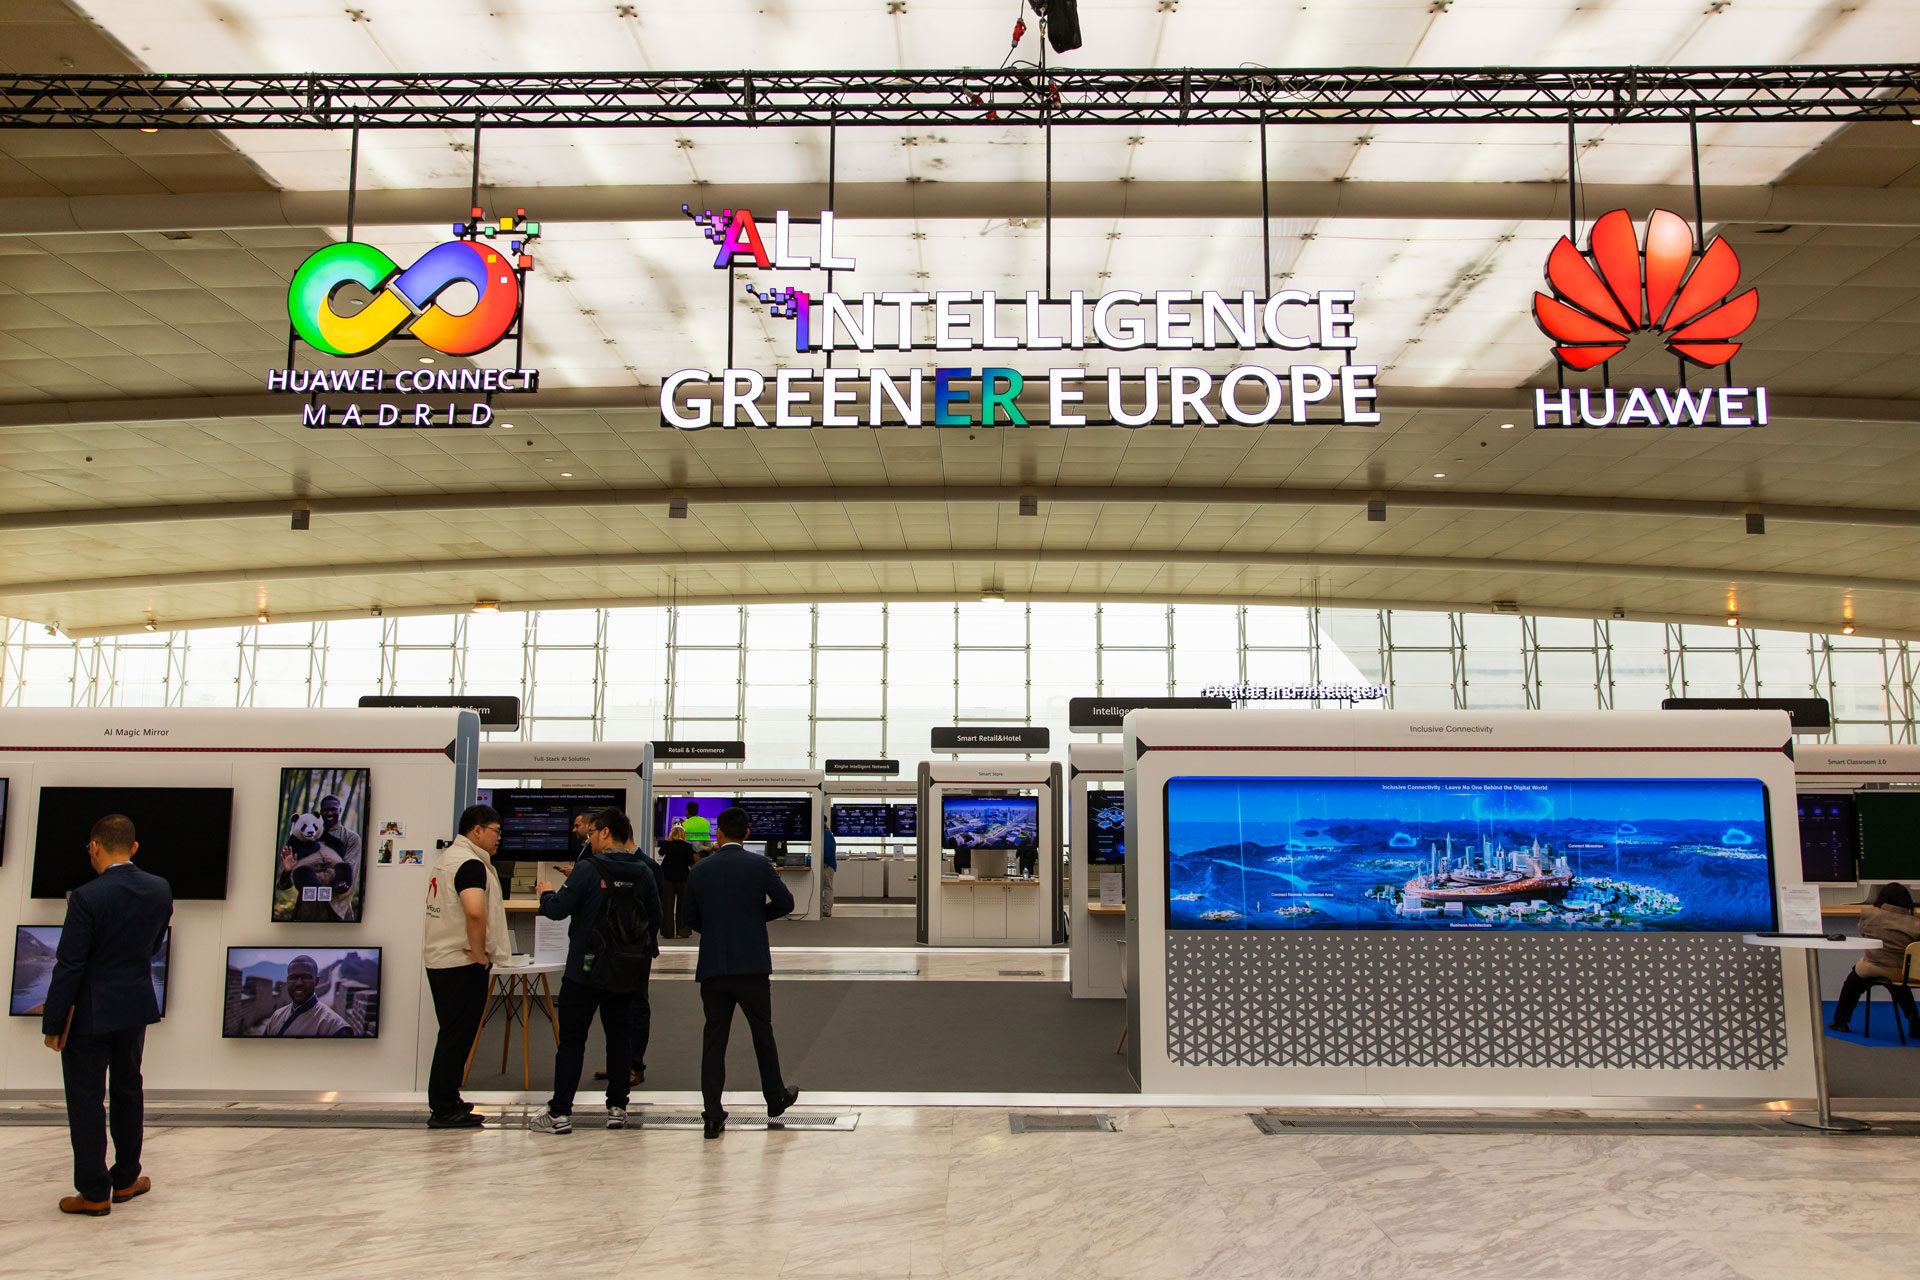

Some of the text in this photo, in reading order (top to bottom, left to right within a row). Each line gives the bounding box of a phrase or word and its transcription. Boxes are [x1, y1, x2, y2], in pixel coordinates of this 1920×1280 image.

[714, 209, 856, 272] ALL
[794, 290, 1359, 353] INTELLIGENCE
[267, 368, 538, 392] HUAWEI CONNECT
[659, 365, 1382, 429] GREENER EUROPE
[1535, 386, 1769, 427] HUAWEI
[302, 404, 493, 427] MADRID
[1205, 684, 1390, 699] Digital and Intelligent
[104, 728, 169, 737] AI Magic Mirror
[1410, 725, 1494, 734] Inclusive Connectivity
